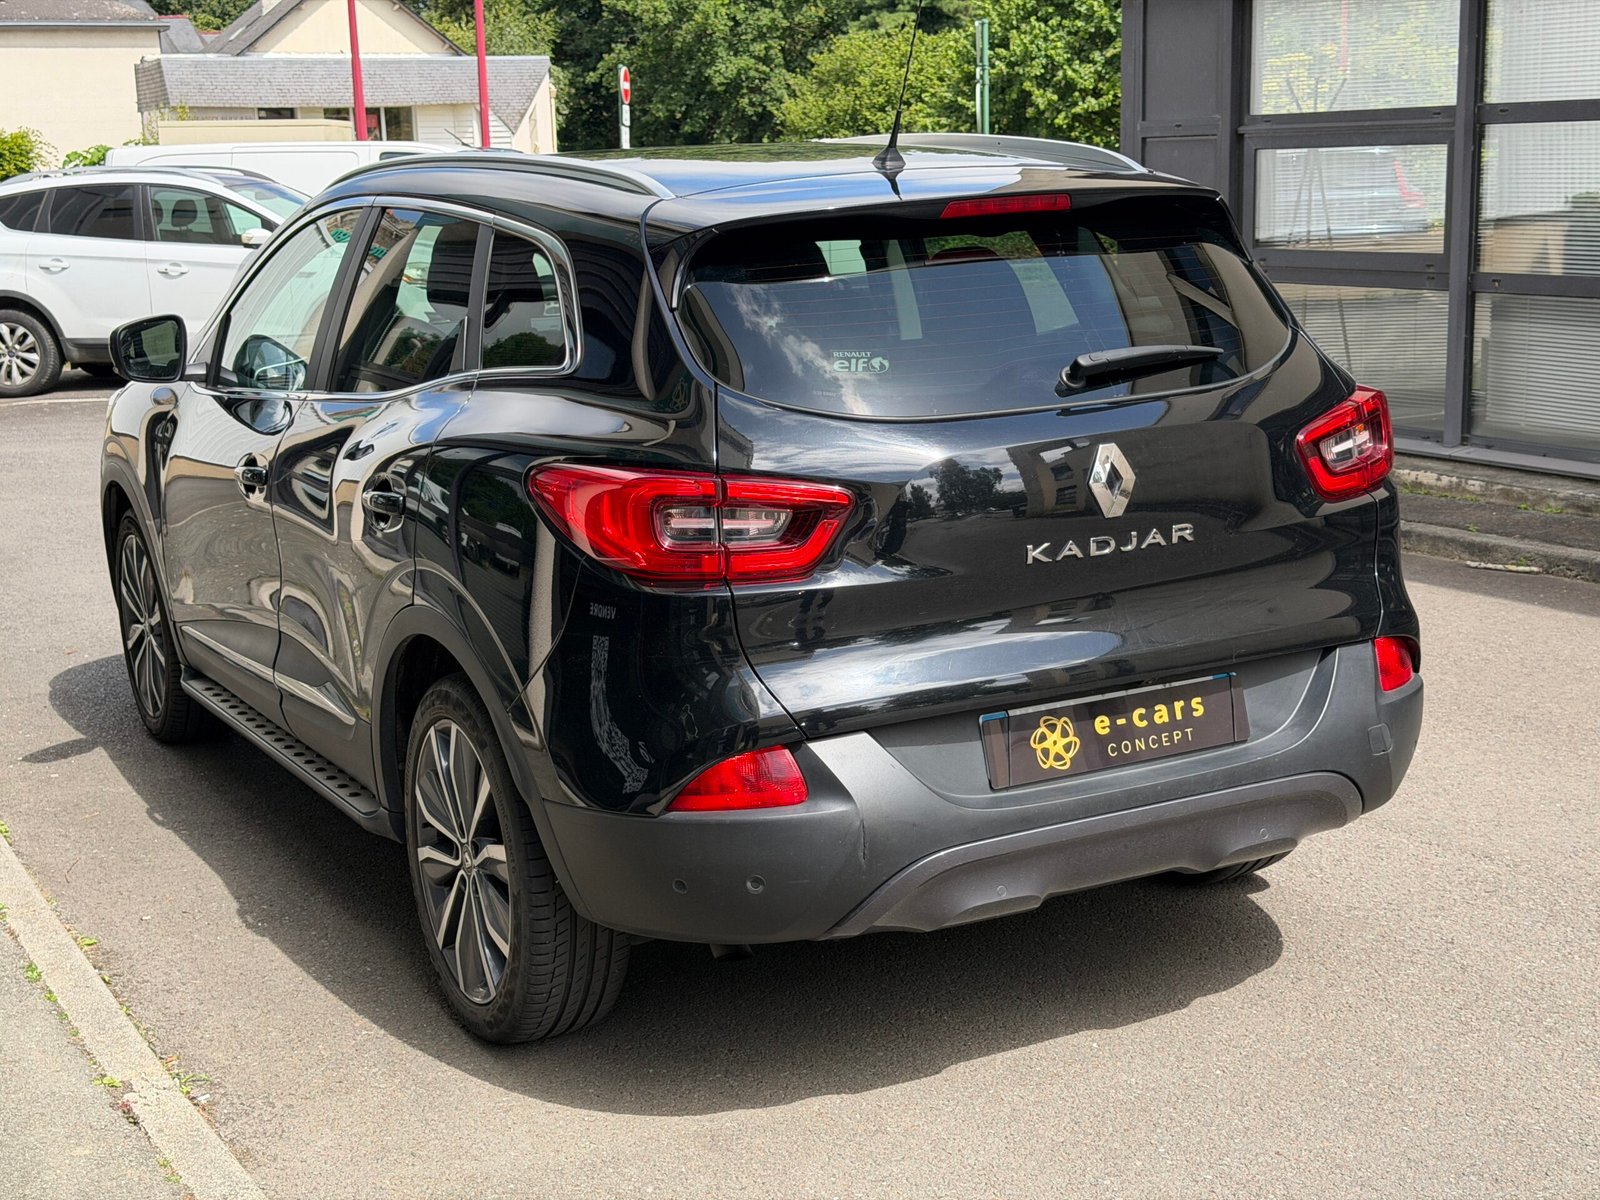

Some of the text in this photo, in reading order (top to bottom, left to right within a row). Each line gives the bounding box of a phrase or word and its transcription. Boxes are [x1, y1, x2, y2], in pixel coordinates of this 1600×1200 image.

[833, 358, 868, 372] elf
[1026, 523, 1195, 565] KADJAR
[1094, 697, 1205, 735] e-cars
[1107, 728, 1194, 757] CONCEPT
